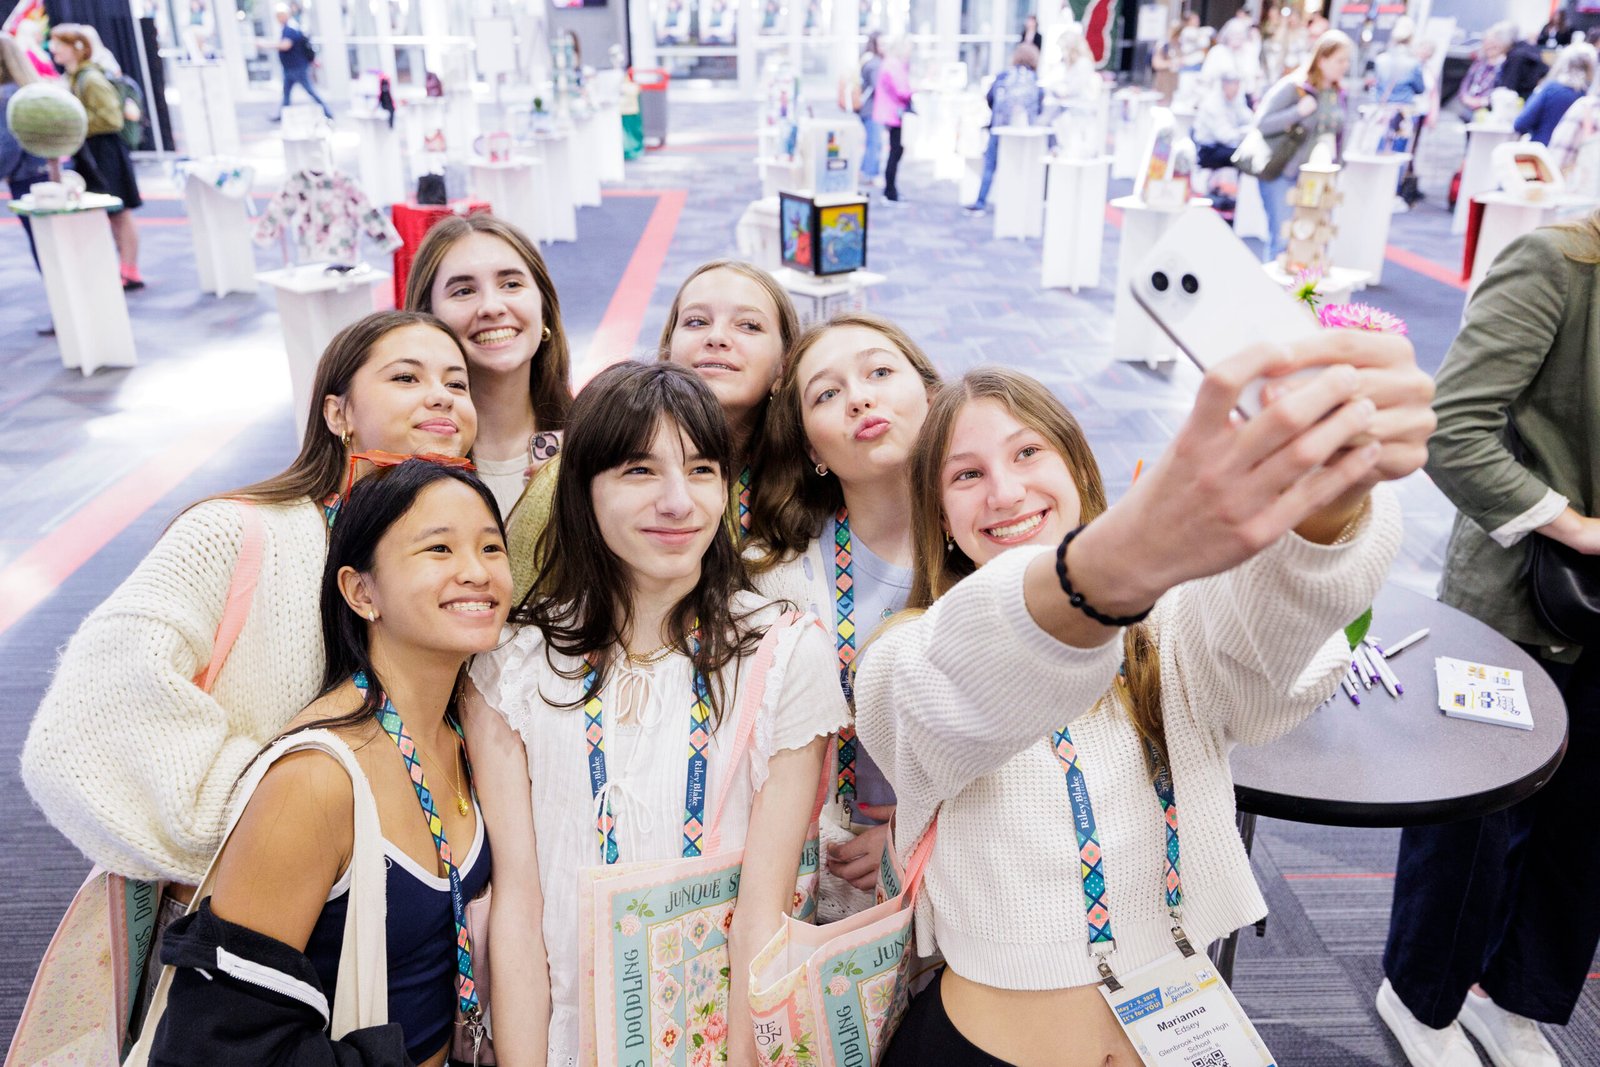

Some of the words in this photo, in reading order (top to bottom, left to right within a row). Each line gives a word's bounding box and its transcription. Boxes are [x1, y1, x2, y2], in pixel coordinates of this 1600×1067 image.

[592, 756, 602, 780] Blake
[690, 760, 704, 782] Riley
[1160, 766, 1170, 792] Blake
[692, 783, 703, 806] Blake
[1070, 775, 1084, 803] Blake
[1077, 803, 1090, 829] Riley
[623, 948, 645, 1049] DOODLING
[1117, 1005, 1129, 1013] May
[1134, 1009, 1145, 1017] for
[1144, 1001, 1161, 1012] YOU!
[1156, 1005, 1206, 1032] Marianna
[1174, 1020, 1200, 1036] Edsey
[1158, 1039, 1192, 1057] Glenbrook
[1192, 1030, 1213, 1042] North
[1211, 1022, 1229, 1034] High
[1187, 1039, 1211, 1053] School
